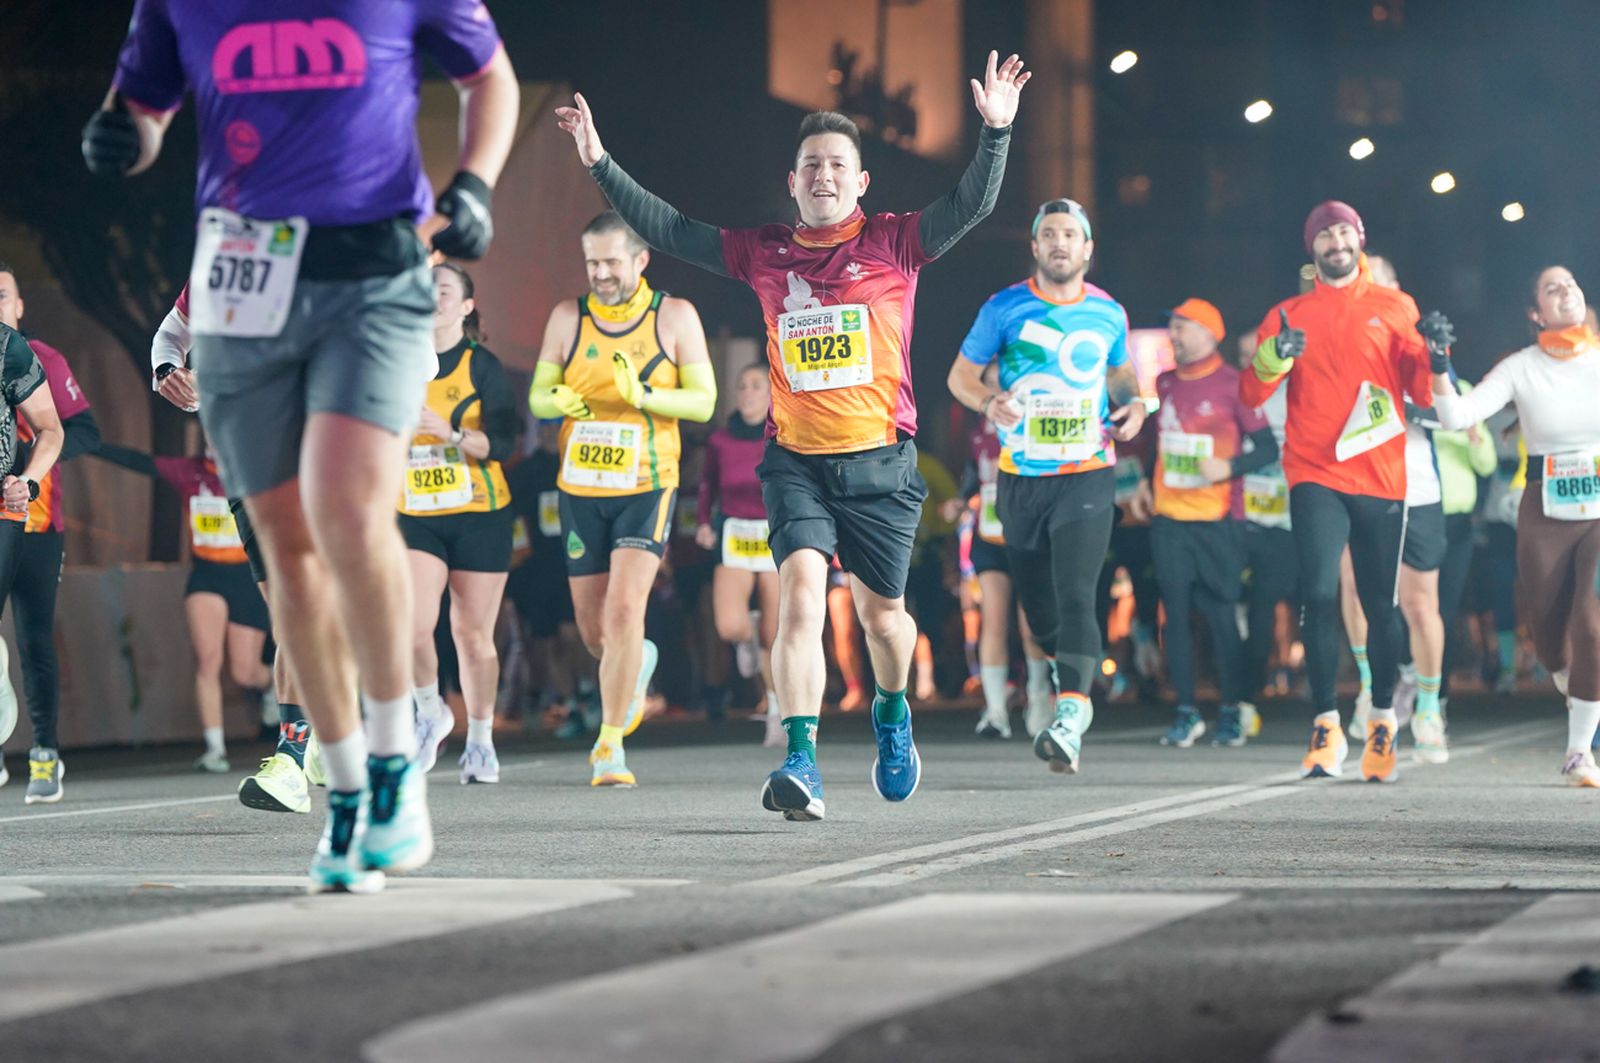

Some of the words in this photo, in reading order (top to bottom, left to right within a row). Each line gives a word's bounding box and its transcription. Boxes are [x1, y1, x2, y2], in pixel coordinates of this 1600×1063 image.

[208, 255, 272, 294] 5787
[797, 316, 822, 327] NOCHE
[824, 315, 834, 325] DE
[788, 328, 804, 339] SAN
[796, 334, 852, 363] 1923
[1039, 418, 1087, 437] 13181
[579, 445, 625, 466] 9282
[414, 467, 455, 488] 9283
